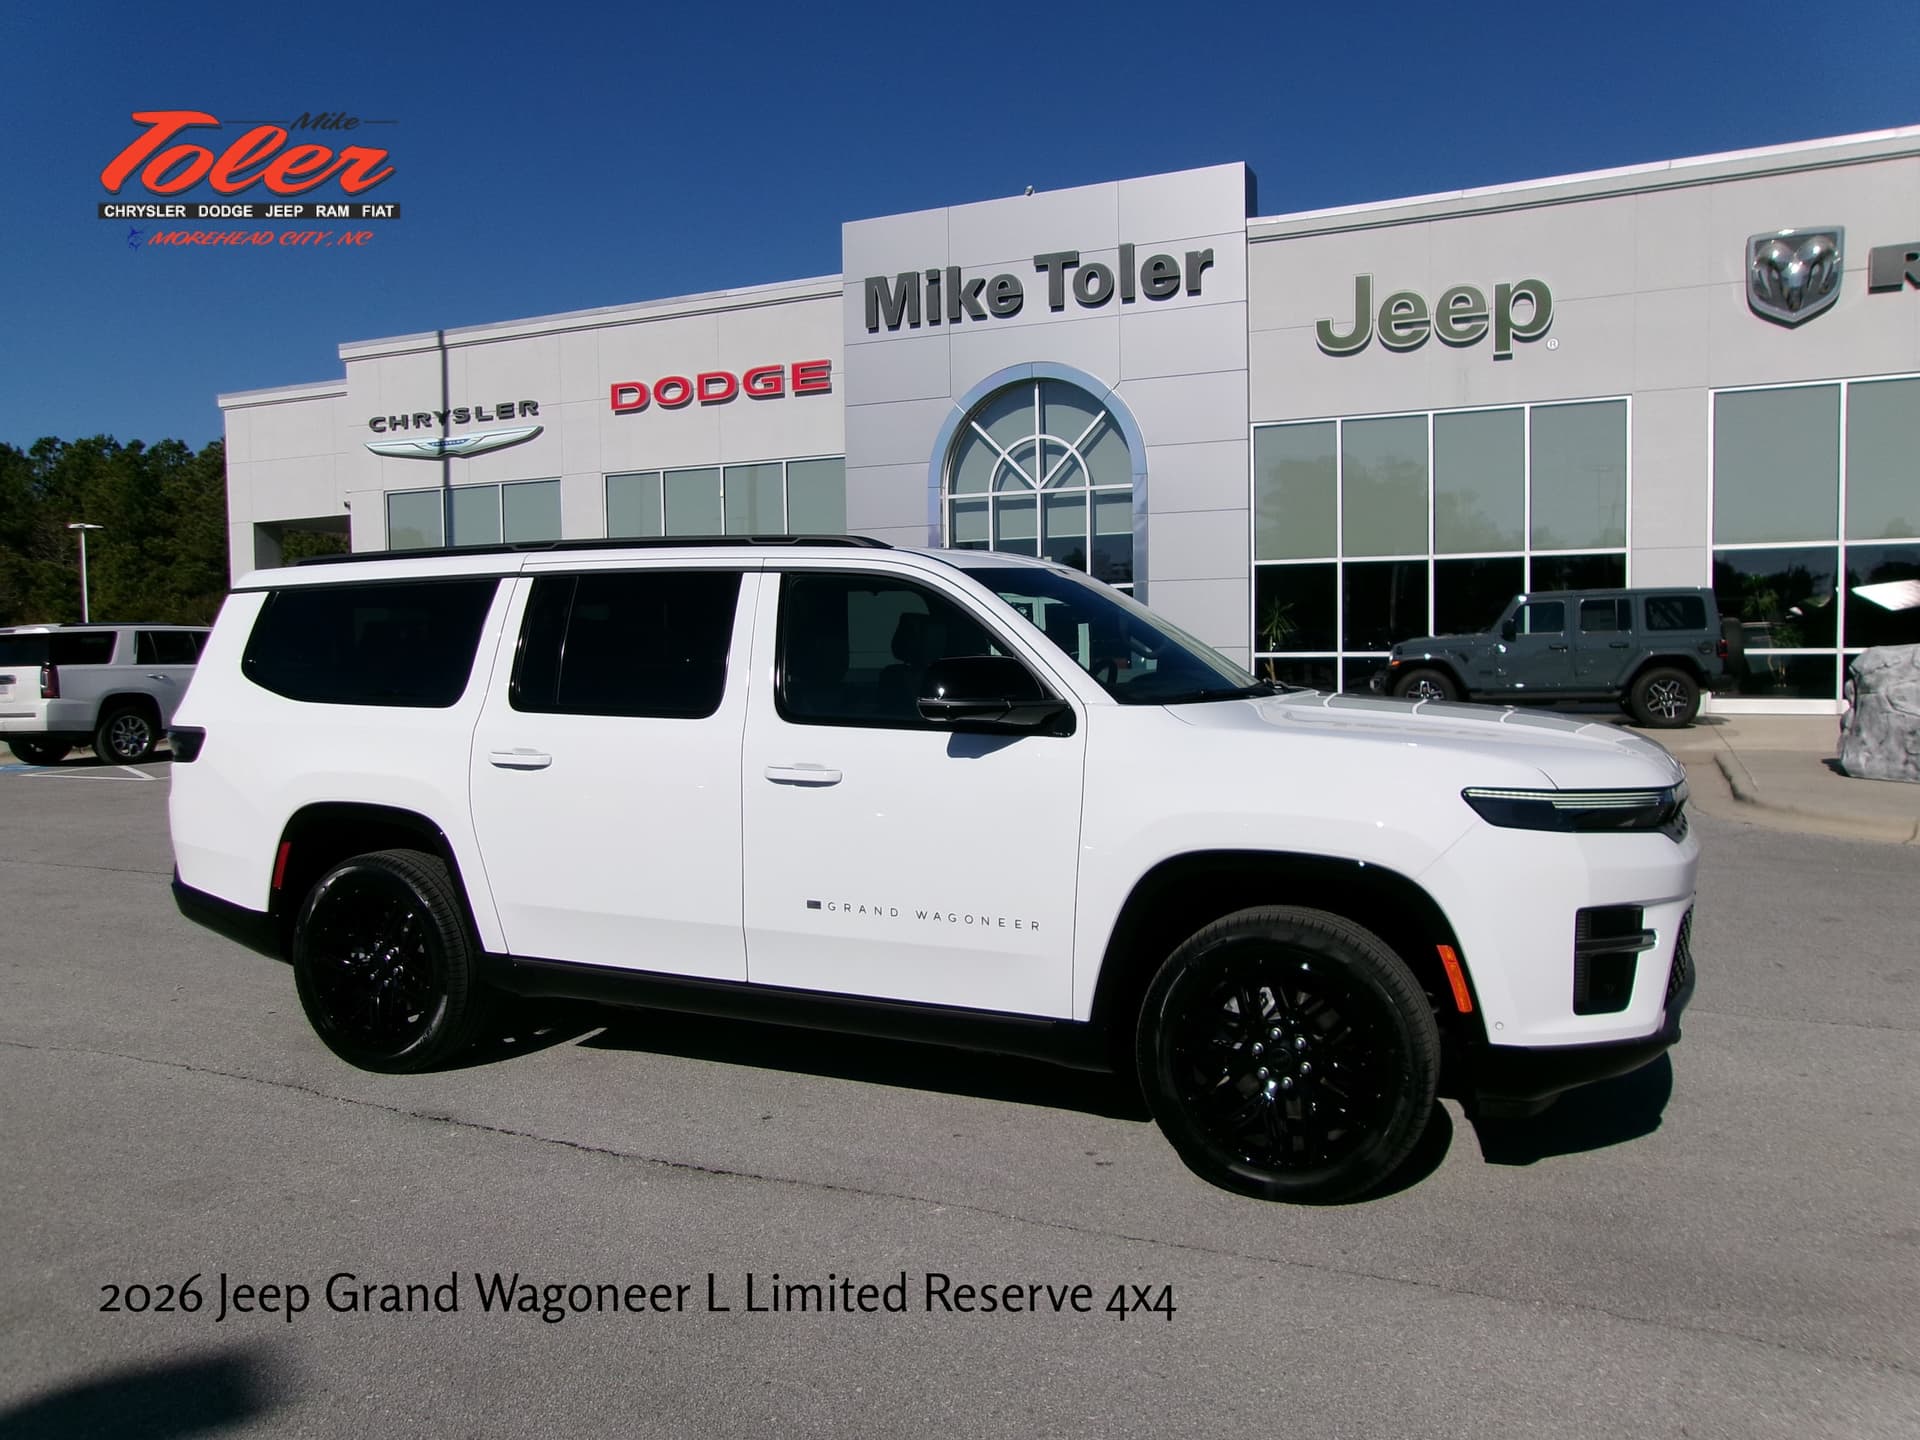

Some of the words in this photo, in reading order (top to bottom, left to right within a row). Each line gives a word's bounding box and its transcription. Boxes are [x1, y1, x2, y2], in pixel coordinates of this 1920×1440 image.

[864, 265, 1024, 334] Mike
[1033, 242, 1214, 313] Toler
[1314, 272, 1555, 361] Jeep
[610, 359, 832, 415] DODGE
[368, 400, 540, 433] CHRYSLER
[827, 901, 899, 918] GRAND
[915, 910, 1040, 932] WAGONEER
